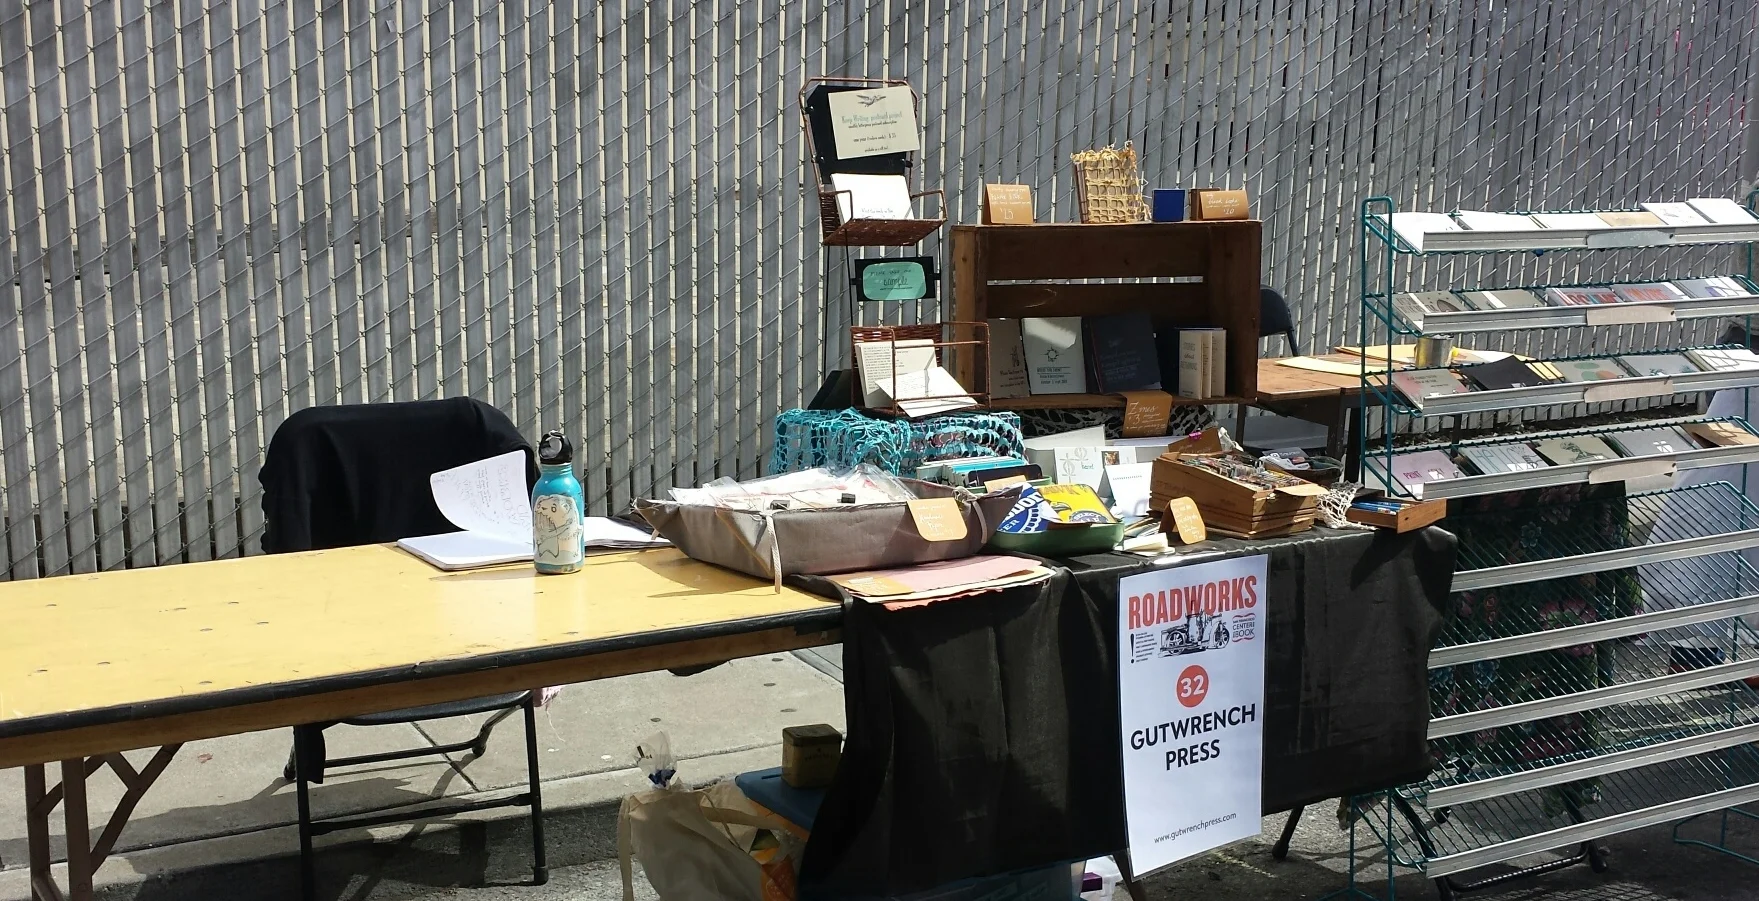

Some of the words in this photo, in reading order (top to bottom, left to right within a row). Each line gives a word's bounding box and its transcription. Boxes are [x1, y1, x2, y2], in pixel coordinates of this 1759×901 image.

[1128, 575, 1257, 630] ROADWORKS
[1180, 675, 1205, 698] 32
[1130, 703, 1256, 751] GUTWRENCH
[1165, 739, 1221, 771] PRESS
[1153, 812, 1237, 845] www.gutwrenchpress.com
